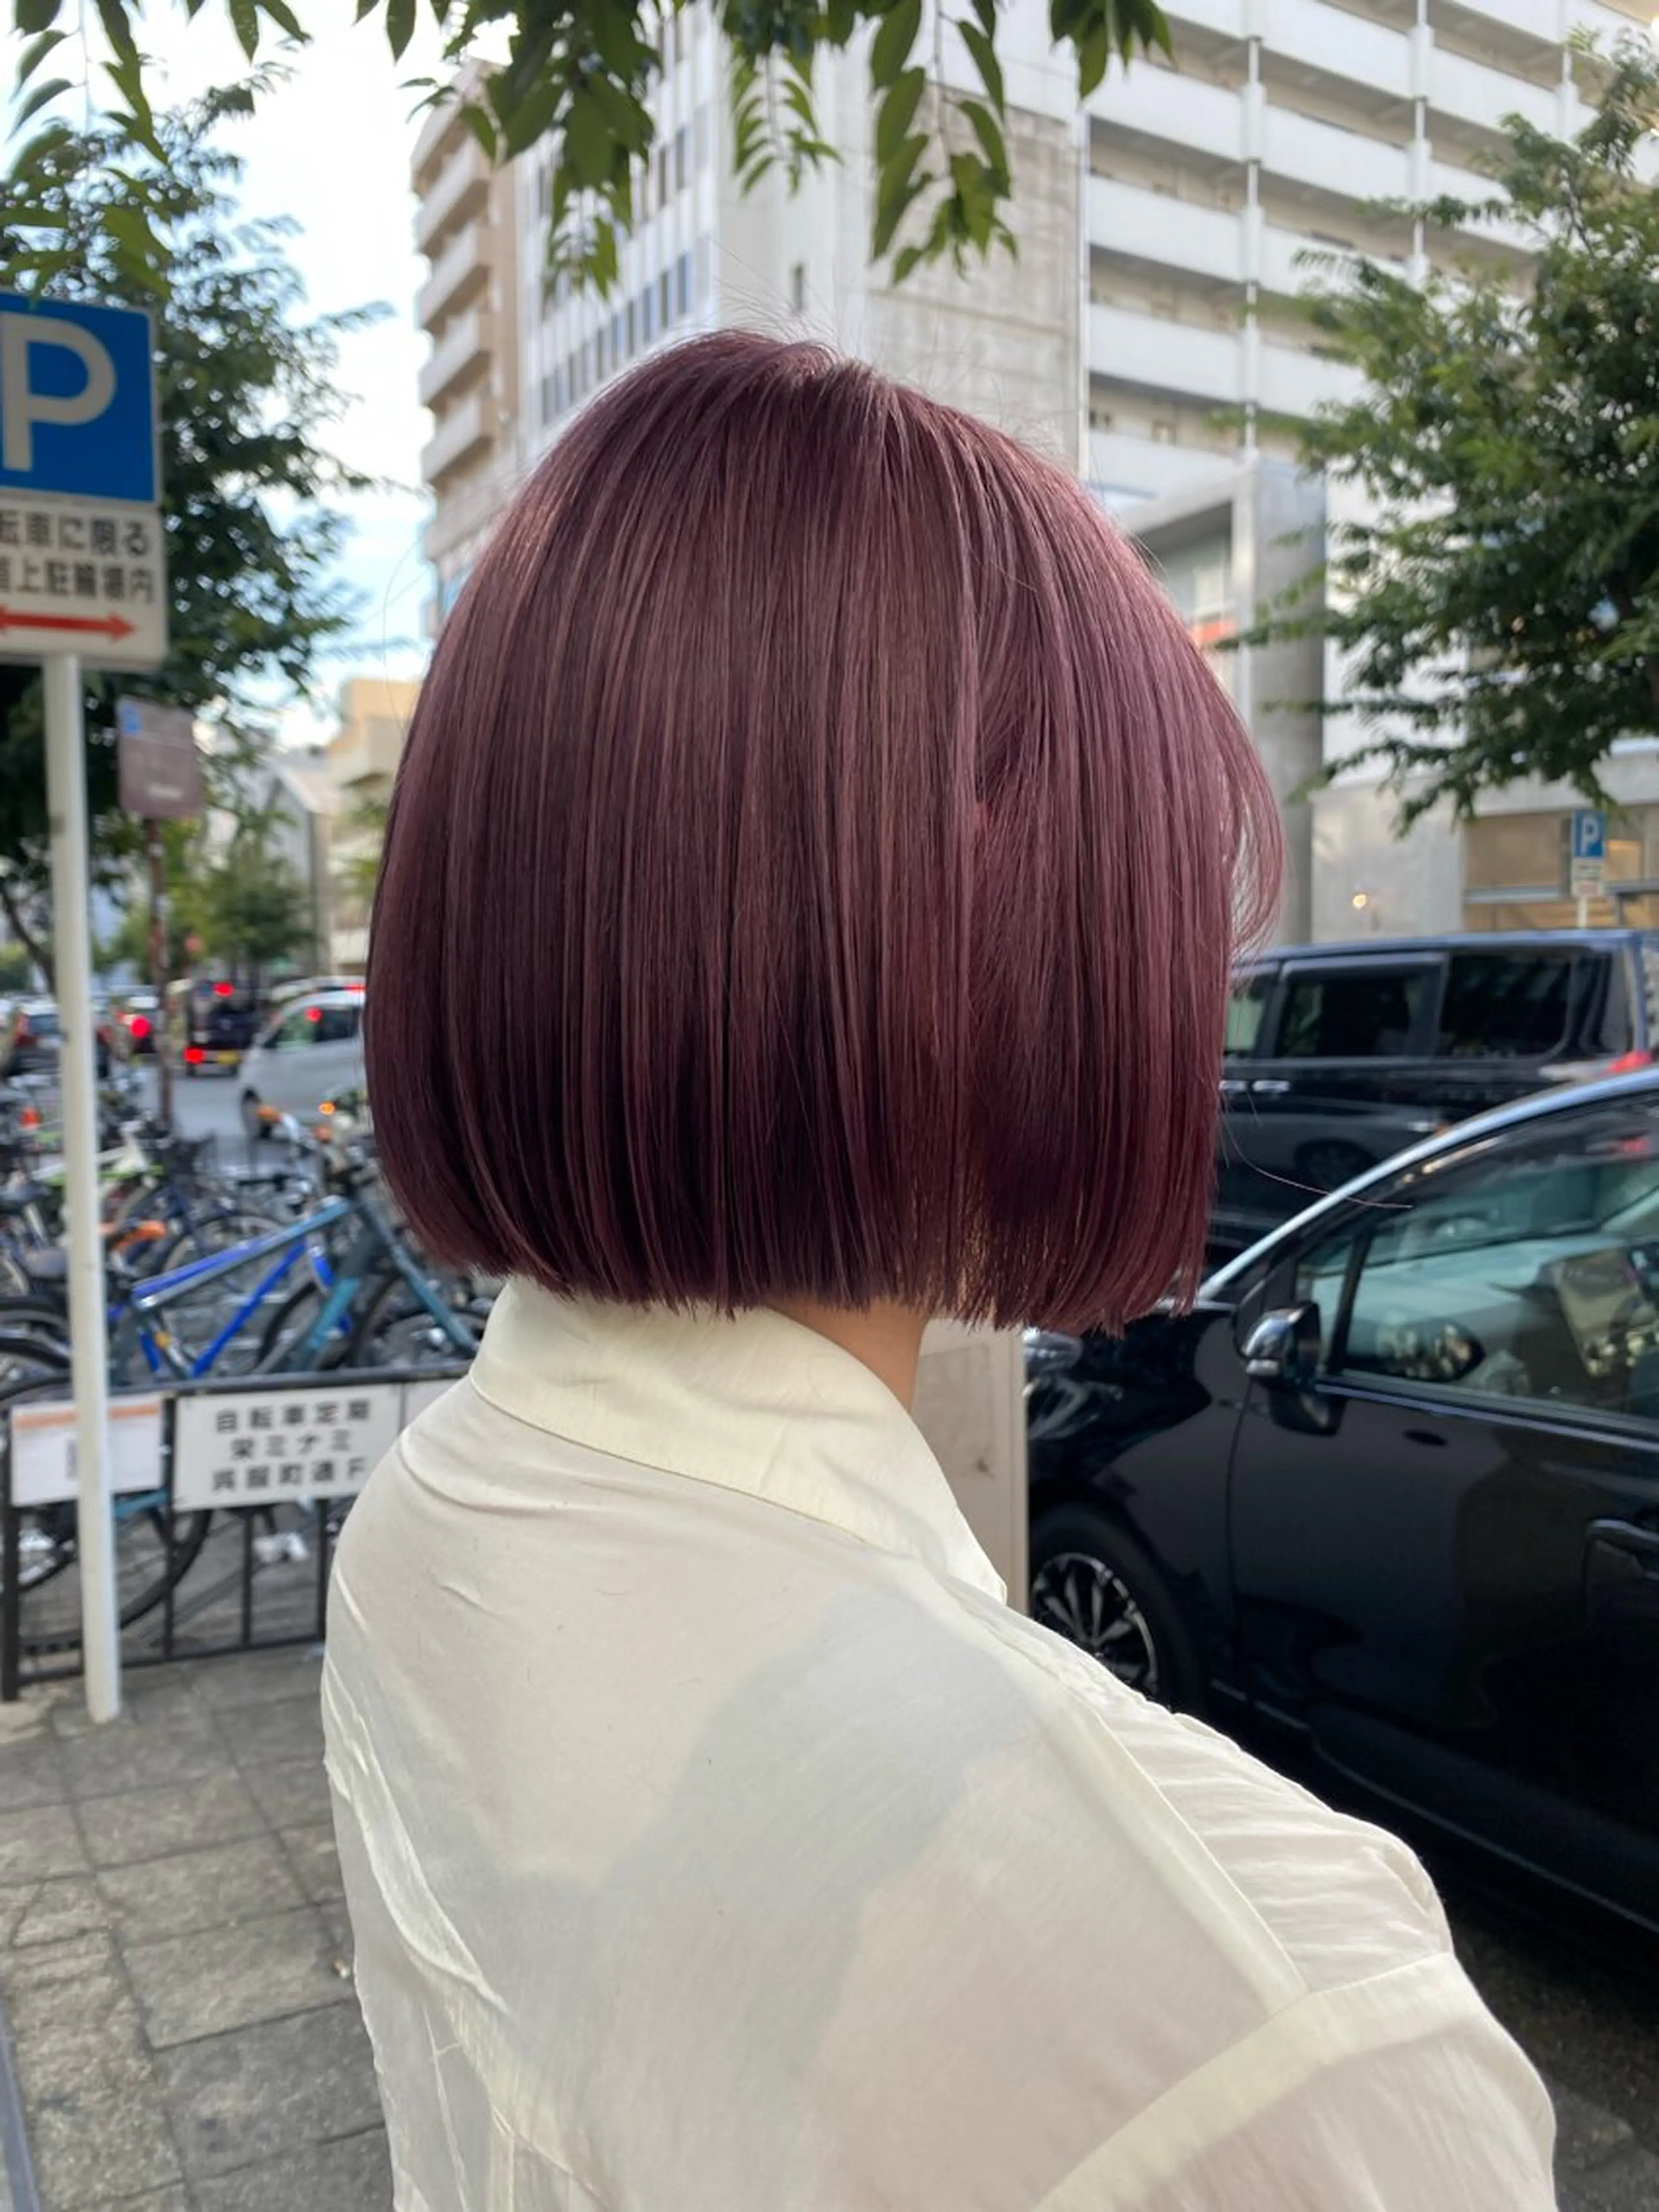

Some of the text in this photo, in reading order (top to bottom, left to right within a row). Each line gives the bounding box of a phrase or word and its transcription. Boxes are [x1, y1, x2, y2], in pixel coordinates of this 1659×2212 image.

[0, 311, 116, 472] P
[1581, 817, 1599, 856] P
[232, 1429, 350, 1459] 栄ミナミ
